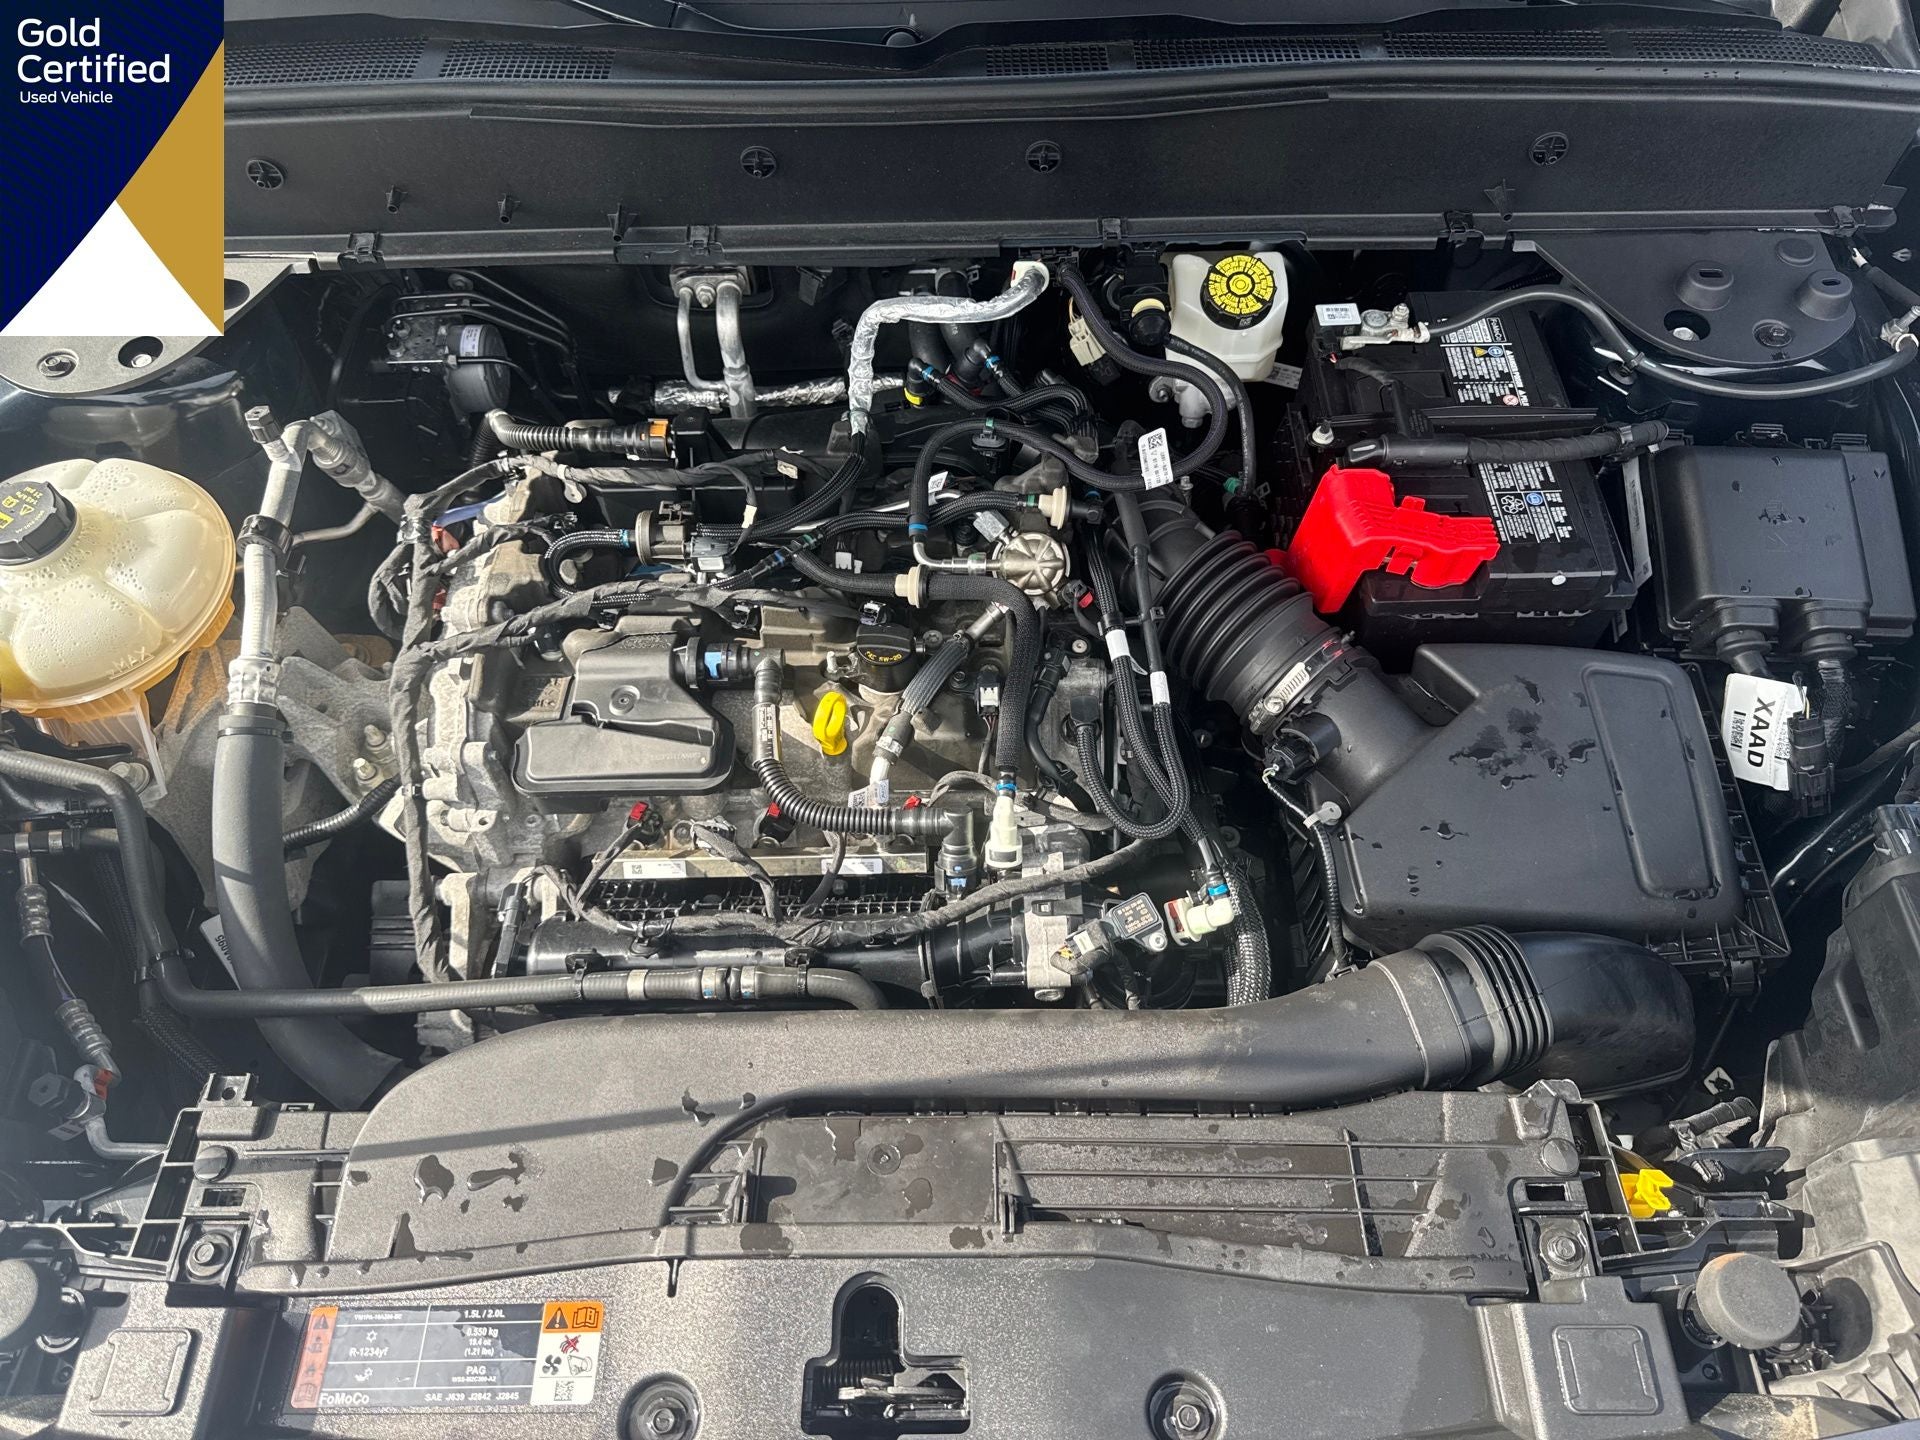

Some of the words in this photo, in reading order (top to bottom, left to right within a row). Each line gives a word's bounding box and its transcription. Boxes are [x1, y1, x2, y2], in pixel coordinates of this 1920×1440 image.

[112, 646, 152, 676] MAX
[1747, 697, 1776, 768] XAAD
[464, 1309, 481, 1319] 1.5L
[487, 1309, 506, 1318] 2.0L
[466, 1327, 488, 1337] 0.550
[488, 1326, 499, 1338] kg
[349, 1347, 389, 1358] R-1234yf
[465, 1365, 487, 1375] PAG
[319, 1392, 370, 1405] FoMoCo
[424, 1393, 443, 1402] SAE
[445, 1392, 466, 1401] J639
[495, 1391, 520, 1401] J2845
